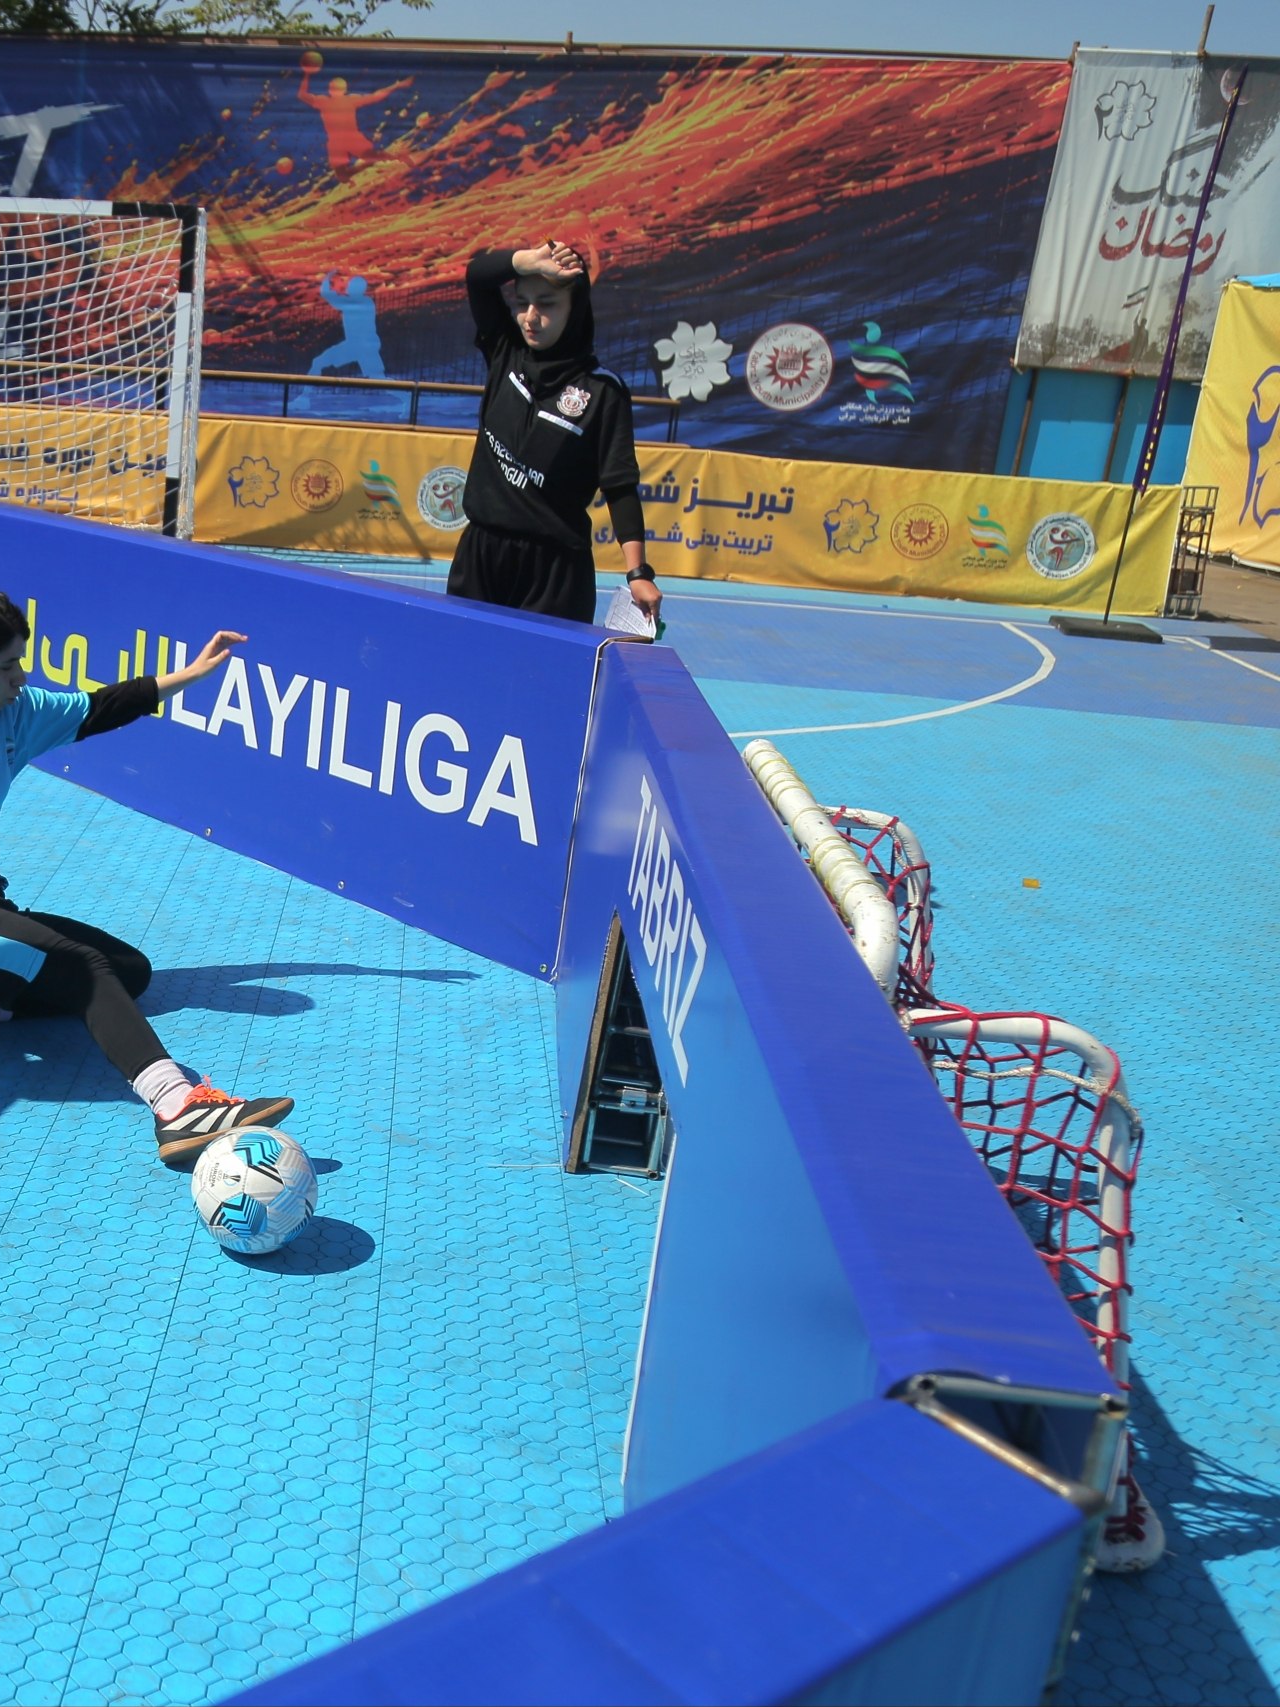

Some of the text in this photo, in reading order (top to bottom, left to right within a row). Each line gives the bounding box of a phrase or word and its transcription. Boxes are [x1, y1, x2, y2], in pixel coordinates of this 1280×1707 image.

[1099, 205, 1227, 276] رمضان
[683, 477, 795, 521] تبریز
[685, 528, 721, 552] بدنی
[722, 530, 773, 556] تربیت
[171, 640, 539, 847] LAYILIGA
[627, 774, 708, 1089] TABRIZ
